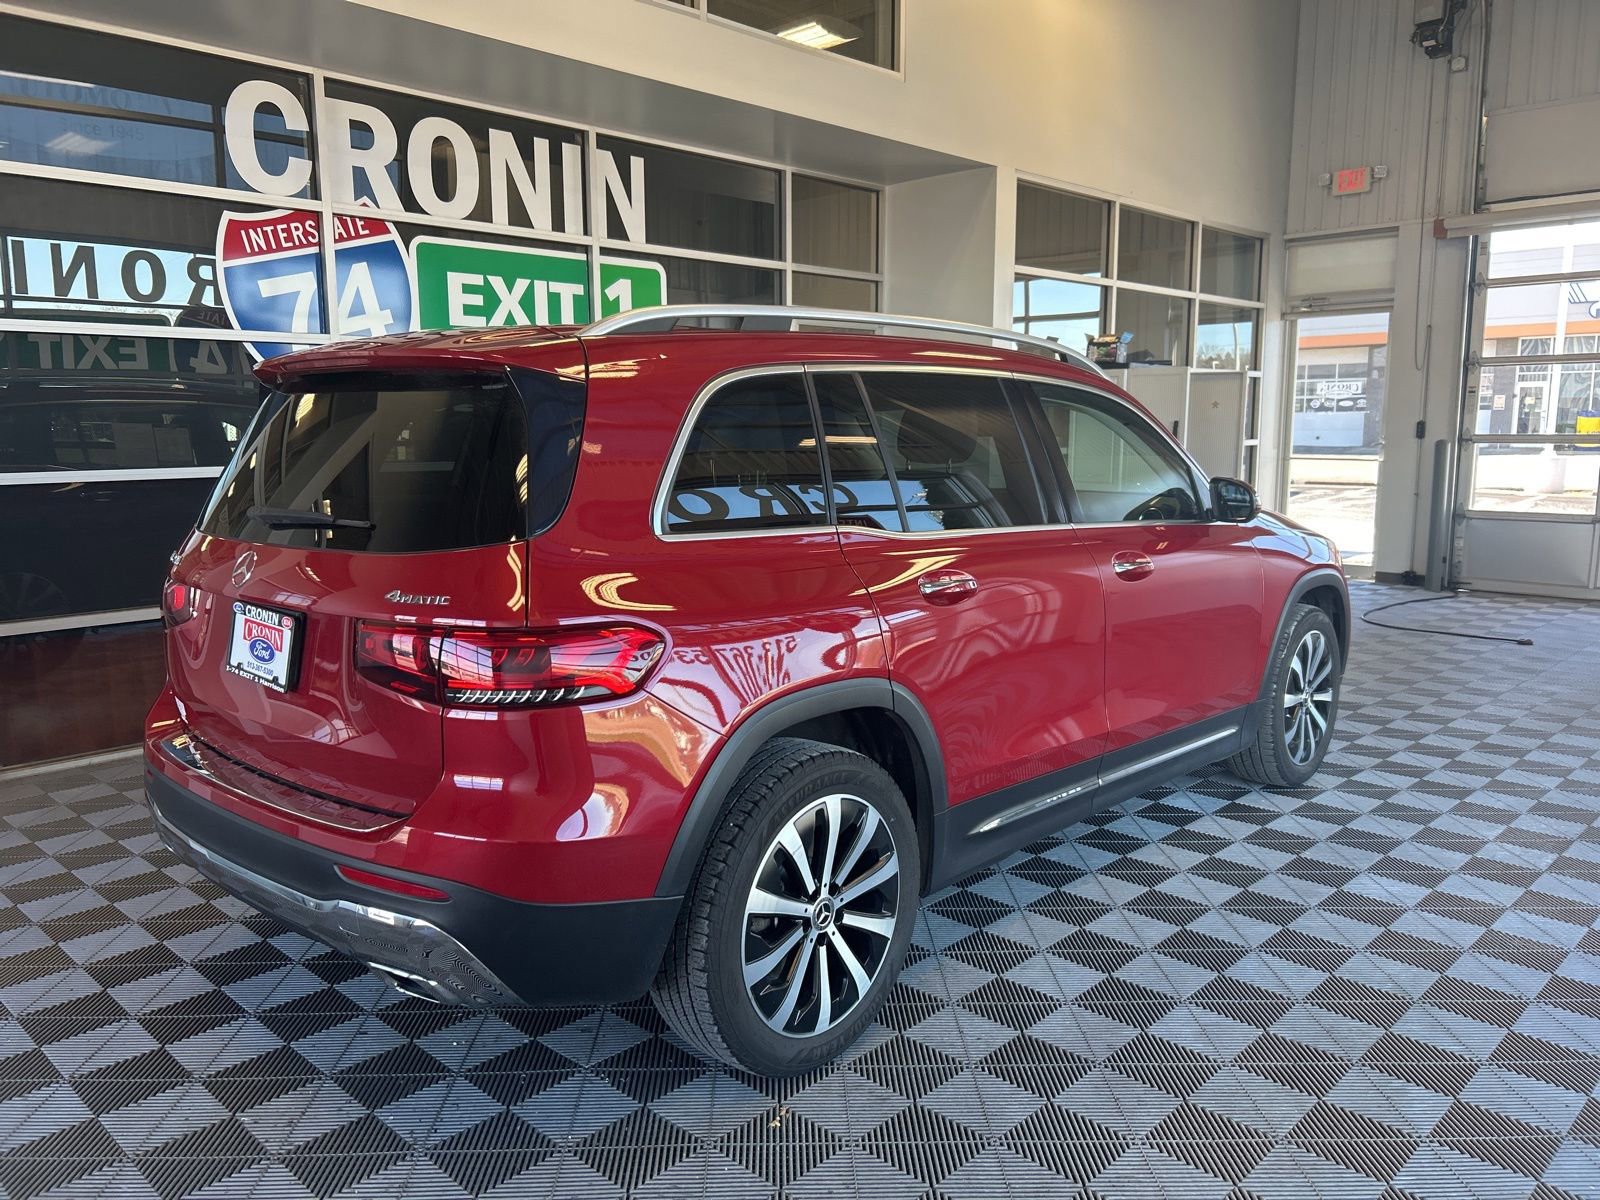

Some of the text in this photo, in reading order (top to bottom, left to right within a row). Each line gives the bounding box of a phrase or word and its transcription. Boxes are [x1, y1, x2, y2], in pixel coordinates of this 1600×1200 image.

[225, 79, 648, 245] CRONIN
[240, 215, 370, 253] INTERSATE
[257, 261, 394, 352] 74
[446, 271, 632, 327] EXIT 1
[384, 590, 451, 605] 4MATIC
[245, 604, 280, 626] CRONIN
[245, 621, 282, 652] CRONIN
[253, 641, 271, 660] Ford
[226, 665, 239, 675] I-74
[239, 670, 254, 681] EXIT
[259, 677, 285, 694] Harrison
